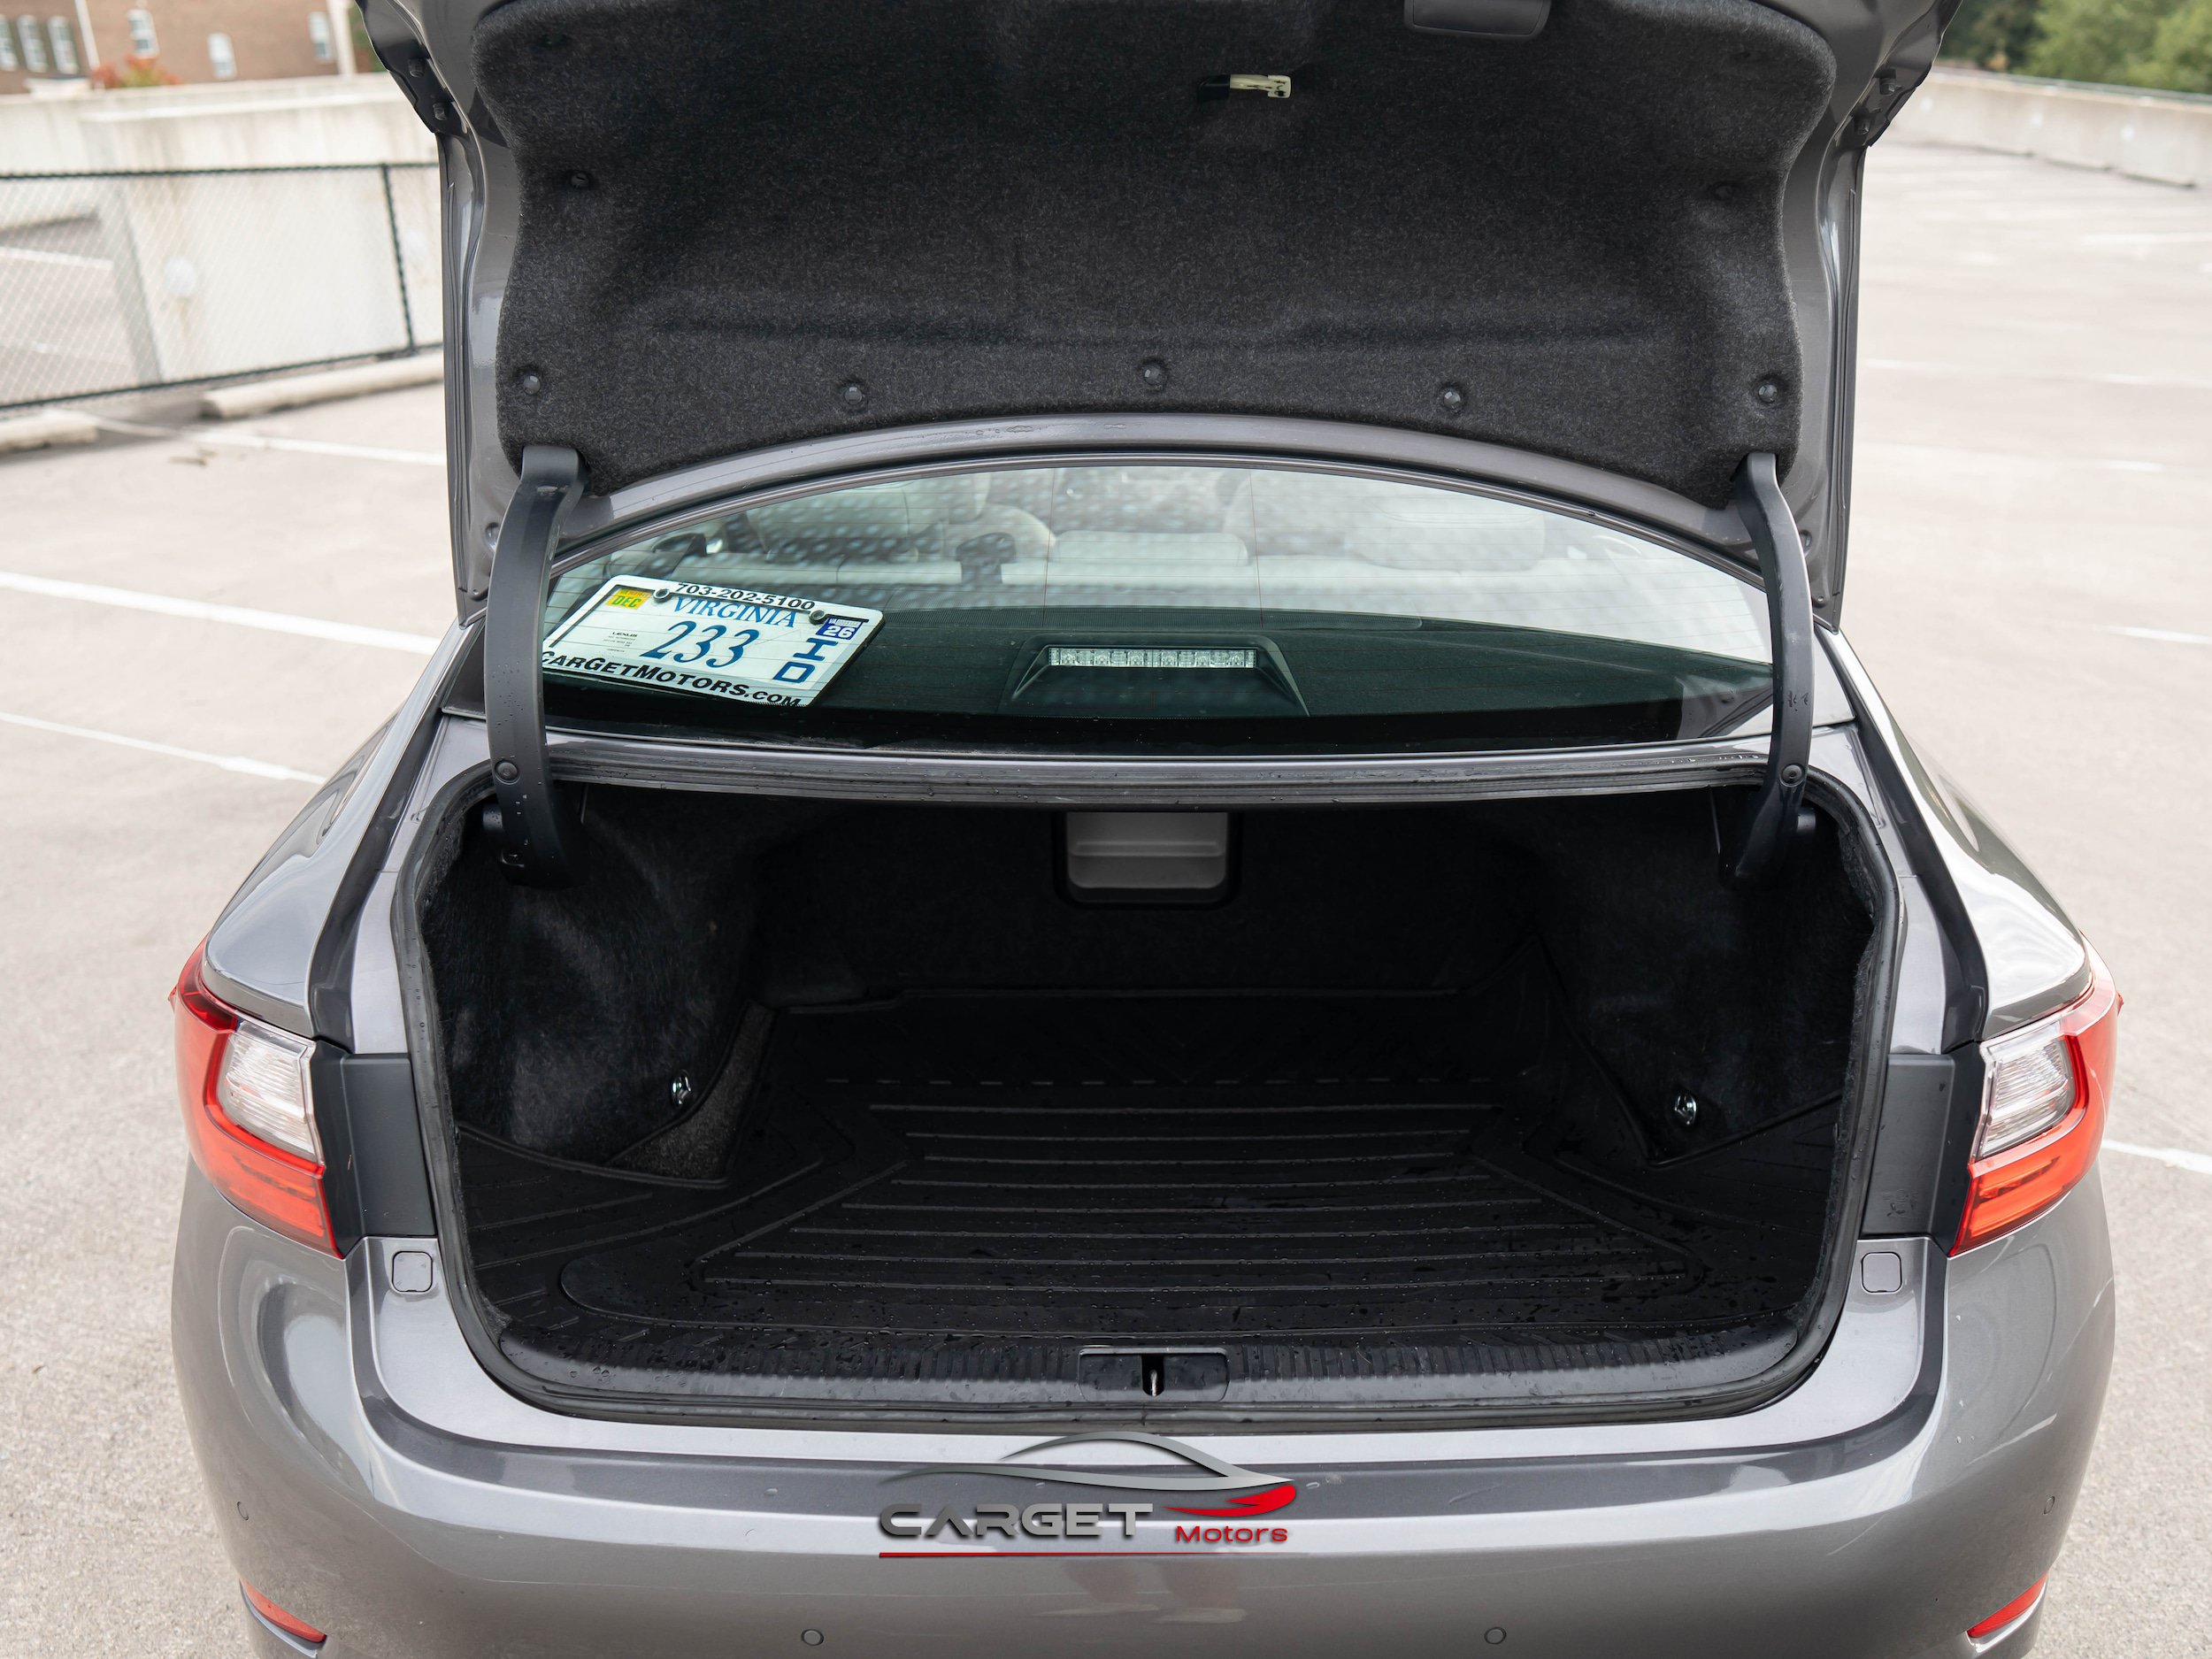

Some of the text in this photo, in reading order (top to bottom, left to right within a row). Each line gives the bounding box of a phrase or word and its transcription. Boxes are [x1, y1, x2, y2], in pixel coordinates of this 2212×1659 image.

[611, 595, 642, 608] DEC
[676, 582, 816, 611] 703-202-5100
[673, 596, 797, 627] VIRGINIA
[639, 620, 760, 668] 233
[823, 625, 856, 638] 26
